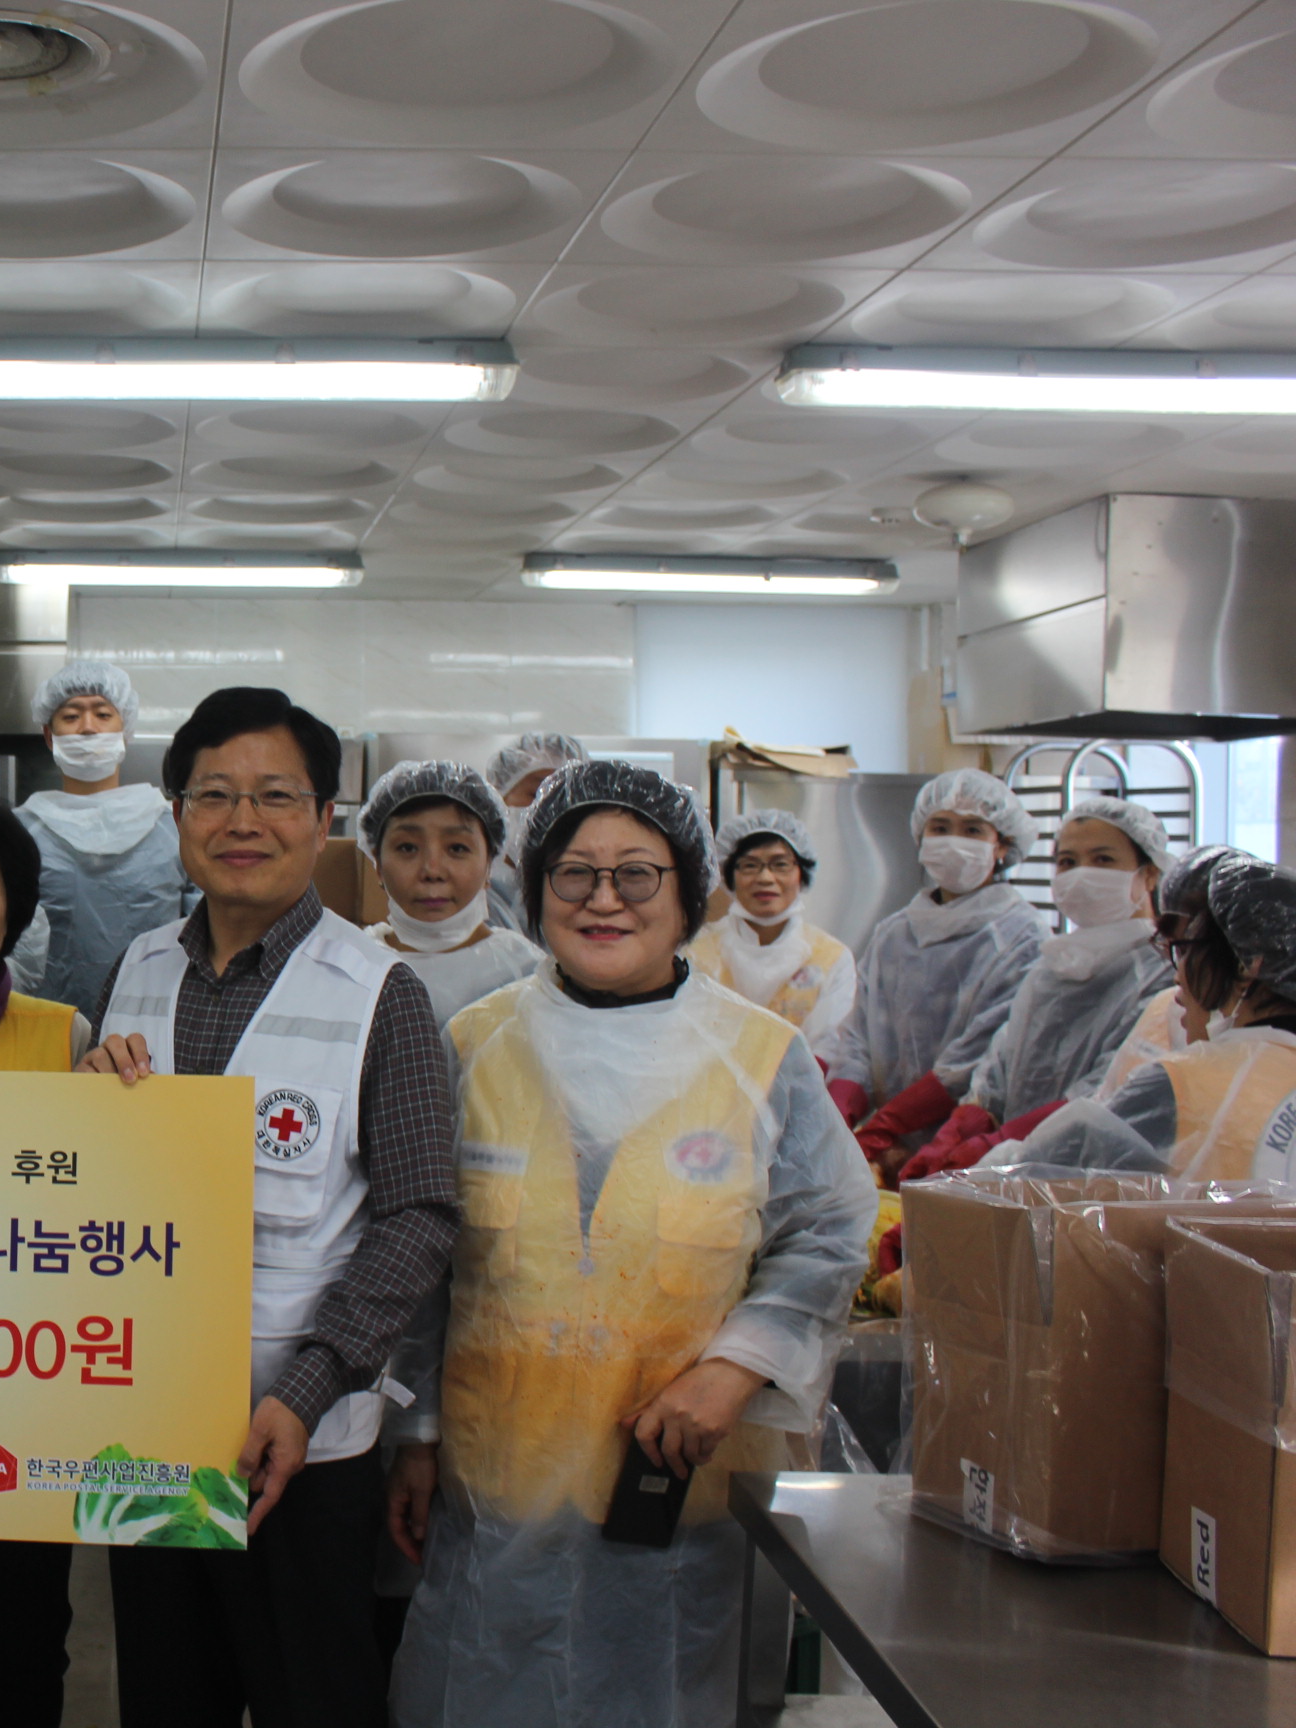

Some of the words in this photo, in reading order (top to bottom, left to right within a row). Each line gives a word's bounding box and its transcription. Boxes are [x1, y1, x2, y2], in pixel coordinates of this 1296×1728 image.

[10, 1149, 80, 1185] 후원
[26, 1458, 191, 1484] 한국우편사업진흥원
[26, 1481, 62, 1491] KOREA
[63, 1482, 102, 1493] POSTAL
[104, 1484, 146, 1495] SERVICE
[147, 1486, 189, 1496] AGENCY
[1196, 1518, 1210, 1588] Red
